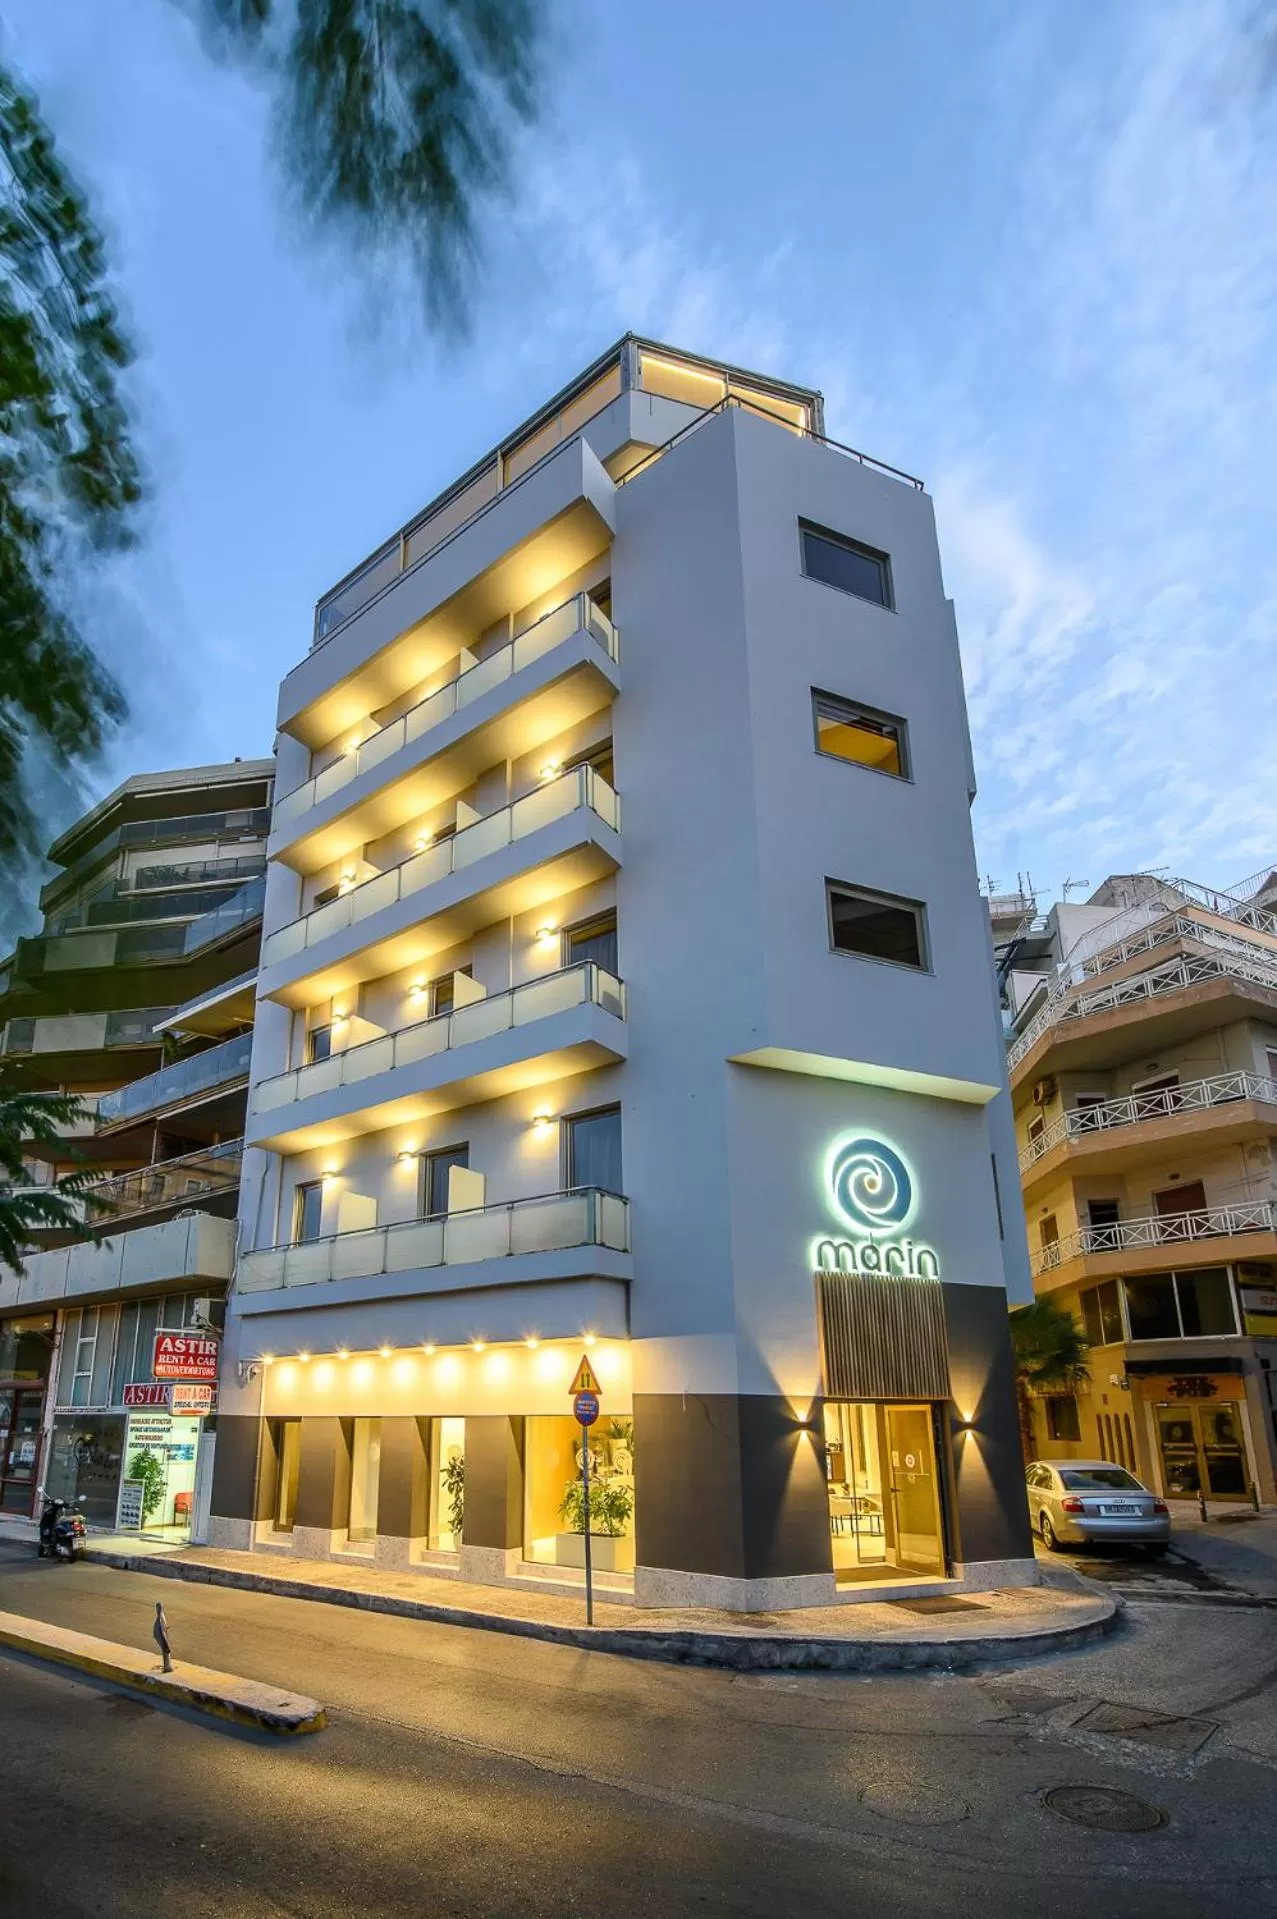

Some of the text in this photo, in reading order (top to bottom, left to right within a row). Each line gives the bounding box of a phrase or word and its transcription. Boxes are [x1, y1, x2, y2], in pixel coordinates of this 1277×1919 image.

[817, 1239, 938, 1276] marin
[160, 1337, 217, 1355] ASTIR
[159, 1355, 216, 1366] RENT A CAR
